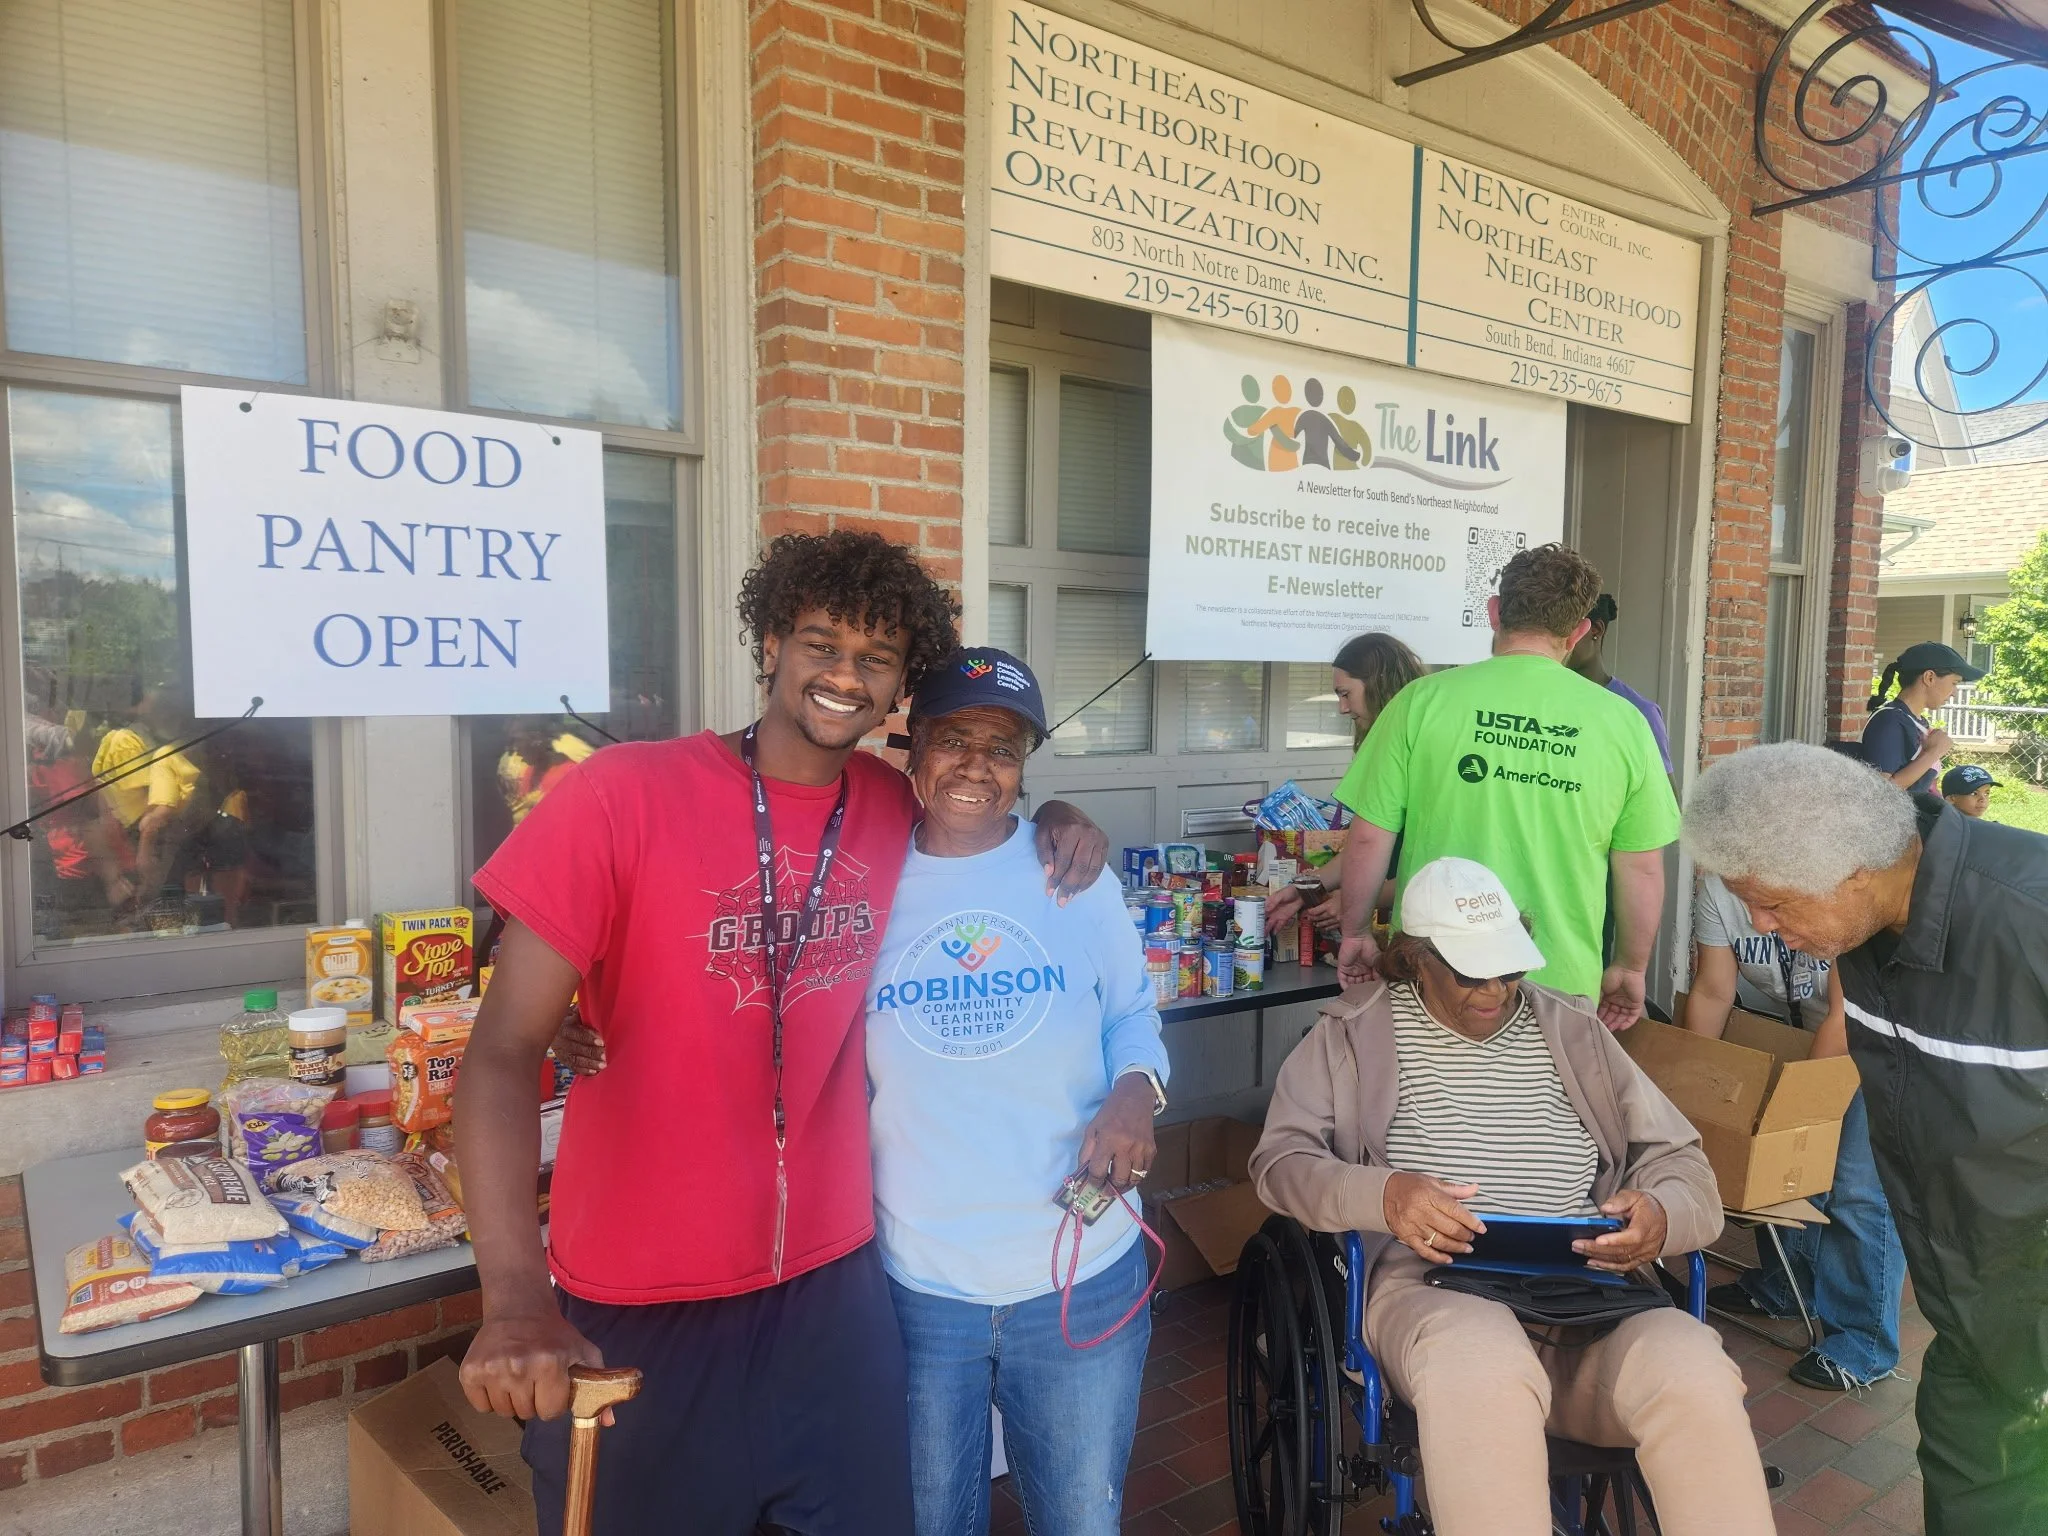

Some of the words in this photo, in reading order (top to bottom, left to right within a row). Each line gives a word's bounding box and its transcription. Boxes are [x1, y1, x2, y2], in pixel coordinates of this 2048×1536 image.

[1007, 9, 1249, 122] NORTHEAST
[1006, 55, 1321, 185] NEIGHBORHOOD
[1007, 102, 1322, 225] REVITALIZATION
[1437, 159, 1549, 226] NENC
[1005, 150, 1311, 264] ORGANIZATION,
[1324, 244, 1383, 281] INC.
[1562, 203, 1605, 229] ENTER
[1437, 203, 1598, 276] NORTHEAST
[1628, 241, 1653, 260] INC.
[1091, 225, 1125, 253] 803
[1133, 234, 1185, 269] North
[1192, 247, 1239, 281] Notre
[1246, 264, 1291, 295] Dame
[1125, 271, 1299, 335] 219-245-6130
[1485, 252, 1681, 329] NEIGHBORHOOD
[1528, 298, 1624, 344] CENTER
[1485, 324, 1521, 350] South
[1525, 333, 1557, 359] Bend,
[1563, 343, 1603, 369] Indiana
[1606, 355, 1636, 377] 46617
[1510, 361, 1623, 405] 219-235-9675
[297, 418, 522, 489] FOOD
[1374, 402, 1421, 455] The
[1425, 408, 1501, 472] Link
[1297, 480, 1305, 492] A
[1306, 481, 1352, 497] Newsletter
[1353, 486, 1364, 499] for
[1366, 489, 1389, 502] South
[1390, 491, 1415, 505] Bend's
[1416, 495, 1452, 509] Northeast
[1453, 499, 1499, 515] Neighborhood
[1209, 503, 1306, 531] Subscribe
[1312, 512, 1331, 533] to
[1337, 518, 1399, 541] receive
[1404, 522, 1431, 542] the
[256, 513, 562, 582] PANTRY
[1184, 534, 1302, 563] NORTHEAST
[1308, 545, 1446, 573] NEIGHBORHOOD
[1267, 575, 1384, 600] E-Newsletter
[313, 612, 522, 669] OPEN
[1475, 710, 1543, 735] USTA
[1474, 730, 1577, 758] FOUNDATION
[1493, 765, 1582, 793] AmeriCorps
[1454, 890, 1502, 913] Perley
[1466, 908, 1503, 924] School
[401, 919, 426, 931] TWIN
[430, 917, 452, 929] PACK
[936, 915, 1031, 944] ANNIVERSARY
[403, 939, 464, 976] Stove
[909, 934, 935, 960] 25th
[1734, 936, 1773, 965] ANN
[425, 958, 456, 982] Top
[804, 973, 842, 990] Since
[876, 965, 1066, 1012] ROBINSON
[425, 981, 456, 997] TURKEY
[922, 996, 1023, 1014] COMMUNITY
[931, 1009, 1015, 1026] LEARNING
[940, 1022, 1005, 1038] CENTER
[427, 1056, 456, 1069] Top
[974, 1040, 1004, 1056] 2001
[207, 1162, 248, 1202] SUPREME
[430, 1420, 507, 1495] PERISHABLE
